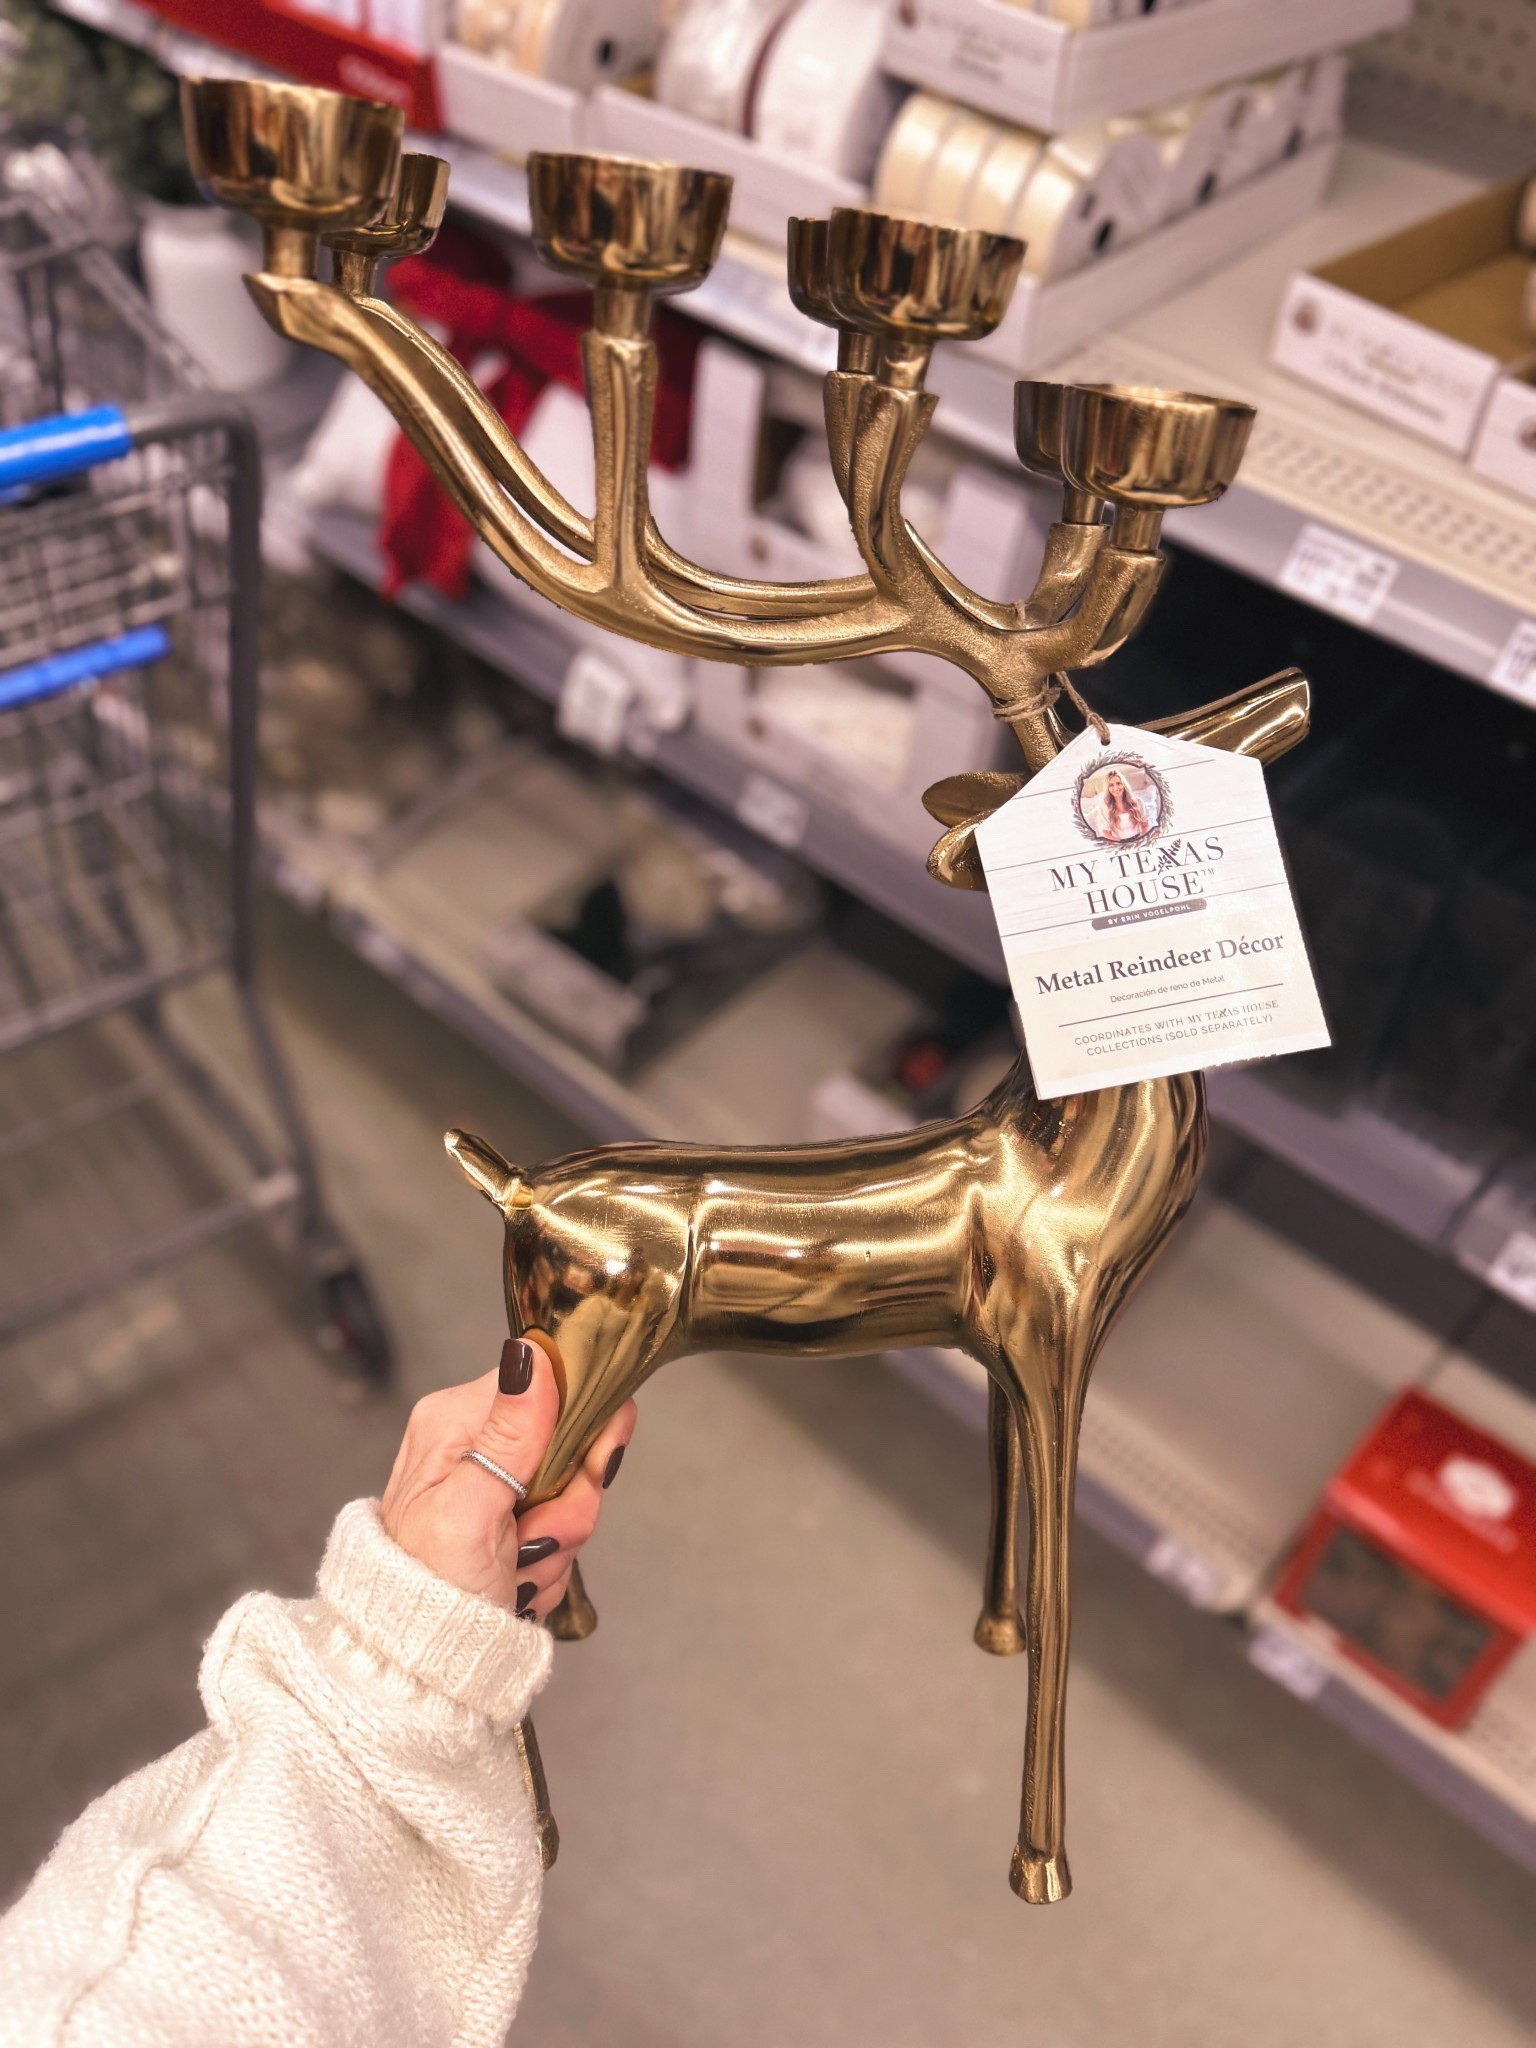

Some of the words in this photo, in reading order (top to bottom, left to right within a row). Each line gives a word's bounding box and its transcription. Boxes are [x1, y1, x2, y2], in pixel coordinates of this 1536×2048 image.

[1048, 860, 1098, 891] MY
[1110, 836, 1224, 878] TEXAS
[1121, 914, 1140, 923] ERIN
[1143, 904, 1191, 918] VOGELPOHL
[1035, 964, 1104, 995] Metal
[1107, 948, 1212, 981] Reindeer
[1216, 935, 1284, 959] Décor
[1110, 988, 1156, 1003] Decoración
[1157, 986, 1168, 994] de
[1170, 982, 1188, 991] reno
[1190, 978, 1201, 988] de
[1202, 974, 1226, 986] Metal
[1074, 1023, 1152, 1046] COORDINATES
[1154, 1018, 1184, 1030] WITH
[1187, 1013, 1203, 1024] MY
[1204, 1007, 1240, 1021] TEXAS
[1242, 999, 1279, 1013] HOUSE
[1086, 1034, 1163, 1056] COLLECTIONS
[1165, 1027, 1198, 1042] (SOLD
[1201, 1013, 1273, 1035] SEPARATELY)
